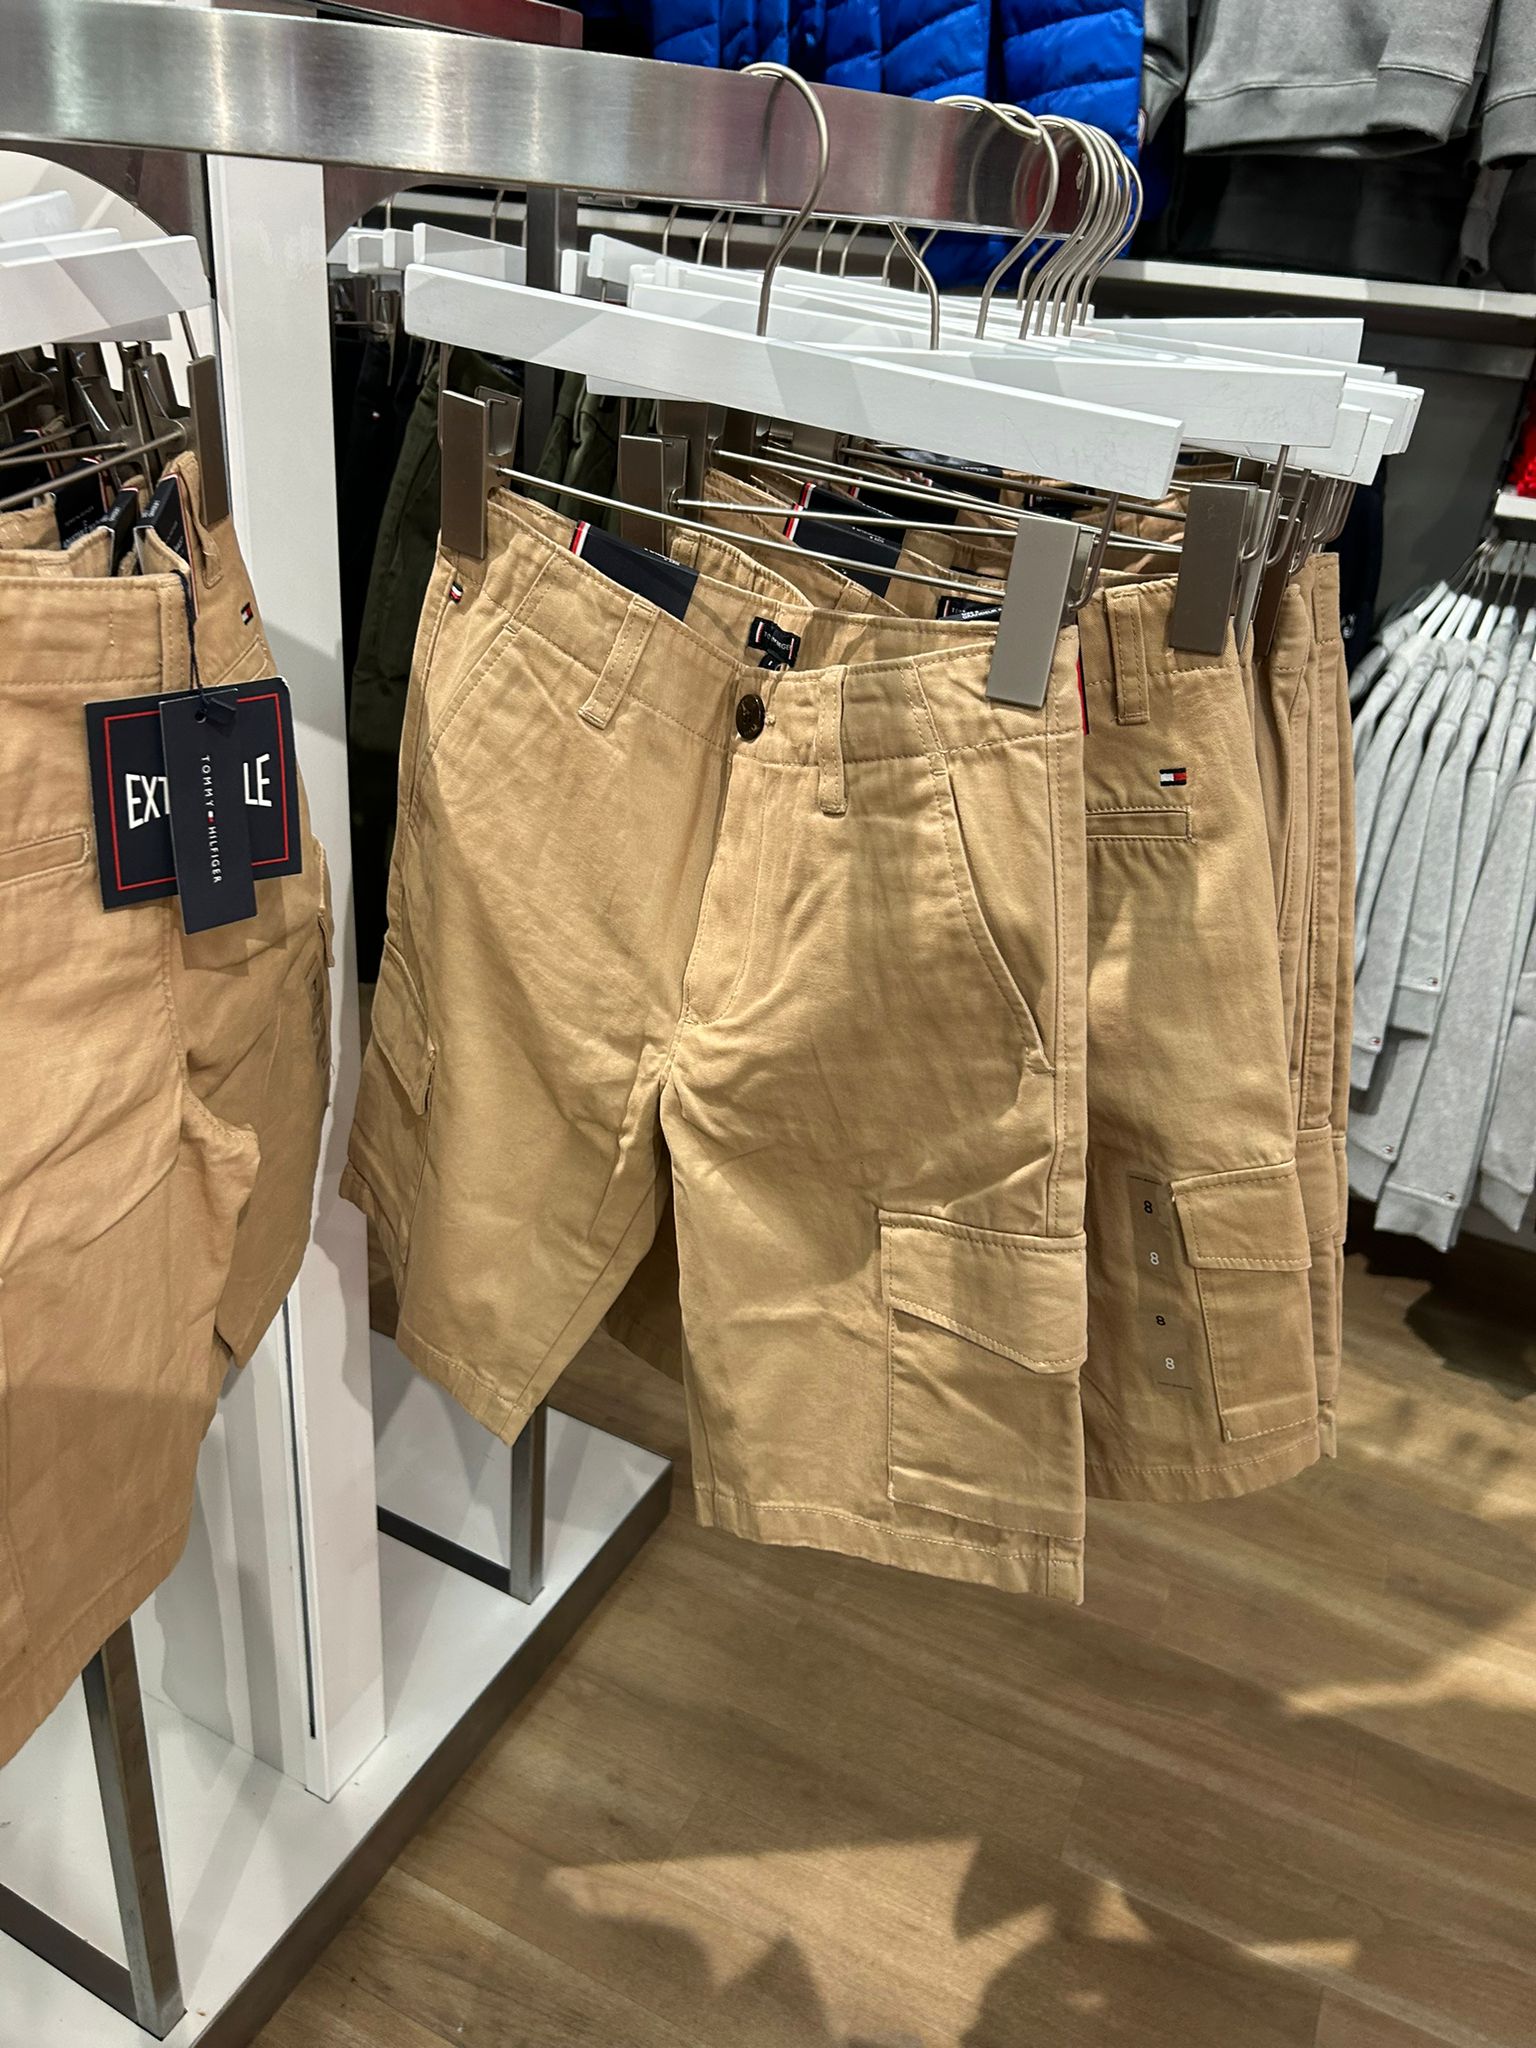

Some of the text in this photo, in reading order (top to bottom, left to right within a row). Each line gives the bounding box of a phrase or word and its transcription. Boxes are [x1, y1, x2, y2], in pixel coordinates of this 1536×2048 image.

[201, 754, 222, 884] TOMMY HILFIGER
[1143, 1200, 1153, 1214] 8
[1149, 1251, 1160, 1266] 8
[1155, 1315, 1166, 1326] 8
[1165, 1357, 1175, 1370] 8
